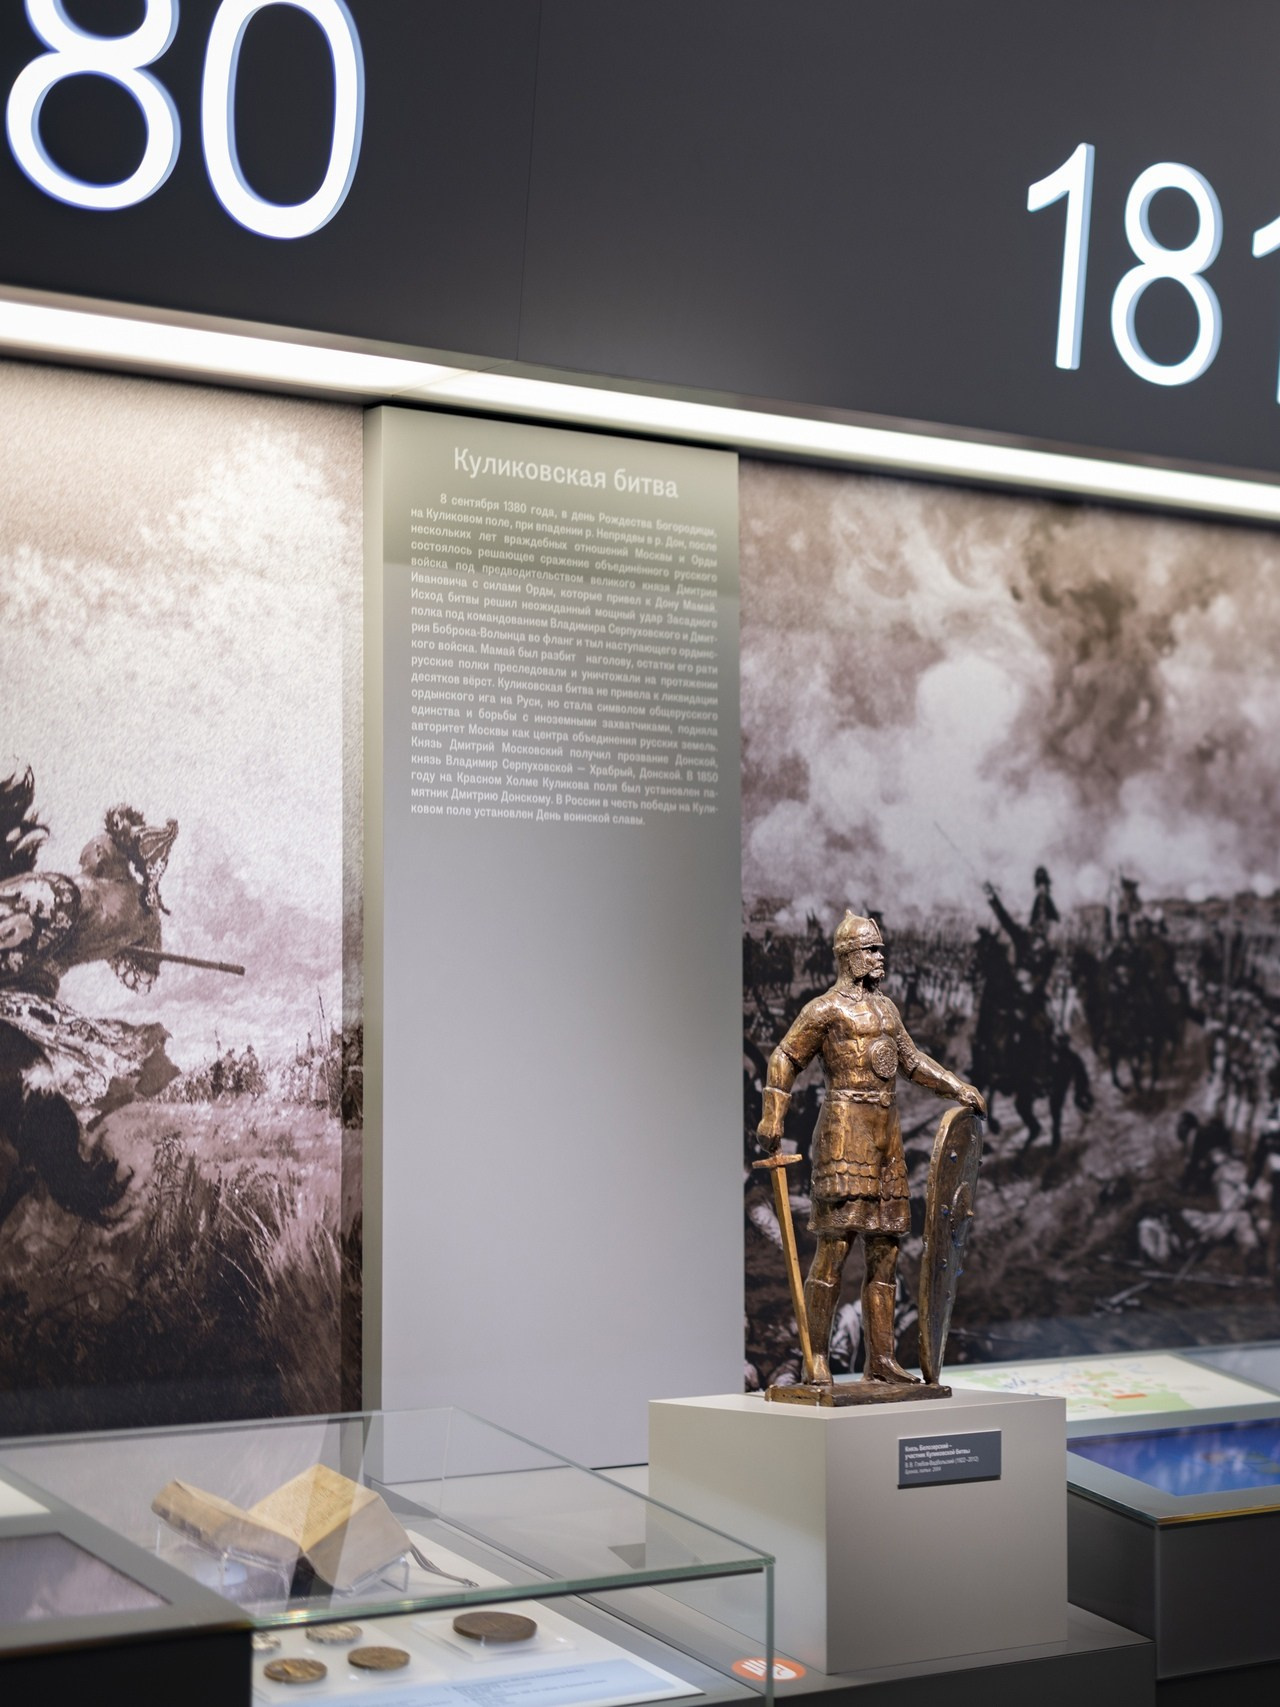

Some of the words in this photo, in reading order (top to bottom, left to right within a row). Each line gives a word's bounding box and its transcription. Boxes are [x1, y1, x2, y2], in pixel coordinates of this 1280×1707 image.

[5, 0, 366, 240] 80
[453, 446, 607, 489] Куликовская
[613, 467, 679, 499] битва
[410, 507, 423, 518] на
[425, 506, 483, 524] Куликовом
[484, 516, 513, 530] поле,
[514, 519, 533, 532] при
[535, 522, 583, 536] впадении
[584, 528, 594, 539] р.
[439, 492, 447, 504] 8
[450, 496, 499, 512] сентября
[502, 499, 527, 514] 1380
[530, 505, 557, 519] года,
[570, 510, 595, 522] день
[597, 511, 652, 529] Рождества
[410, 524, 471, 539] нескольких
[478, 531, 496, 542] лет
[503, 534, 567, 550] враждебных
[573, 542, 628, 557] отношений
[410, 540, 472, 556] состоялось
[477, 547, 535, 563] решающее
[539, 554, 590, 568] сражение
[410, 556, 448, 569] войска
[455, 561, 475, 574] под
[481, 564, 584, 583] предводительством
[589, 575, 636, 589] великого
[410, 570, 467, 587] Ивановича
[471, 579, 478, 588] с
[482, 580, 521, 592] силами
[524, 582, 556, 598] Орды,
[559, 588, 602, 602] которые
[410, 586, 444, 603] Исход
[447, 590, 479, 605] битвы
[483, 596, 517, 608] решил
[520, 600, 591, 616] неожиданный
[594, 607, 636, 620] мощный
[410, 605, 443, 618] полка
[444, 608, 465, 622] под
[466, 611, 548, 627] командованием
[549, 616, 606, 634] Владимира
[410, 622, 430, 634] рия
[432, 621, 526, 643] Боброка-Волынца
[527, 633, 540, 643] во
[541, 632, 574, 646] фланг
[575, 638, 582, 647] и
[584, 638, 603, 649] тыл
[410, 638, 435, 650] кого
[437, 640, 477, 653] войска.
[479, 642, 515, 656] Мамай
[517, 645, 538, 659] был
[540, 649, 576, 662] разбит
[585, 654, 634, 669] наголову,
[410, 655, 454, 668] русские
[457, 659, 489, 670] полки
[493, 662, 567, 677] преследовали
[570, 669, 577, 678] и
[580, 670, 641, 683] уничтожали
[410, 671, 460, 685] десятков
[462, 675, 494, 688] вёрст.
[497, 676, 563, 693] Куликовская
[564, 681, 594, 695] битва
[609, 687, 651, 700] привела
[410, 688, 474, 702] ордынского
[477, 693, 496, 703] ига
[499, 695, 512, 705] на
[516, 693, 543, 709] Руси,
[546, 699, 560, 709] но
[562, 700, 593, 711] стала
[596, 702, 646, 715] символом
[410, 704, 460, 717] единства
[465, 709, 473, 718] и
[477, 707, 517, 722] борьбы
[521, 713, 528, 722] с
[533, 714, 597, 727] иноземными
[410, 720, 465, 735] авторитет
[467, 722, 509, 737] Москвы
[511, 728, 530, 738] как
[532, 729, 569, 743] центра
[571, 730, 637, 746] объединения
[410, 735, 442, 749] Князь
[448, 737, 495, 753] Дмитрий
[501, 741, 563, 756] Московский
[569, 748, 611, 761] получил
[410, 754, 442, 765] князь
[445, 753, 498, 771] Владимир
[501, 757, 573, 773] Серпуховской
[589, 763, 636, 779] Храбрый,
[410, 770, 435, 784] году
[439, 772, 452, 782] на
[456, 770, 502, 785] Красном
[505, 774, 538, 787] Холме
[541, 776, 590, 791] Куликова
[592, 781, 618, 792] поля
[620, 780, 641, 793] был
[410, 787, 448, 798] мятник
[450, 787, 498, 803] Дмитрию
[499, 789, 553, 807] Донскому.
[555, 792, 563, 805] В
[564, 793, 601, 807] России
[610, 798, 639, 809] честь
[410, 803, 443, 814] ковом
[445, 805, 471, 816] поле
[473, 807, 533, 819] установлен
[534, 807, 561, 822] День
[562, 811, 610, 823] воинской
[611, 814, 645, 825] славы.
